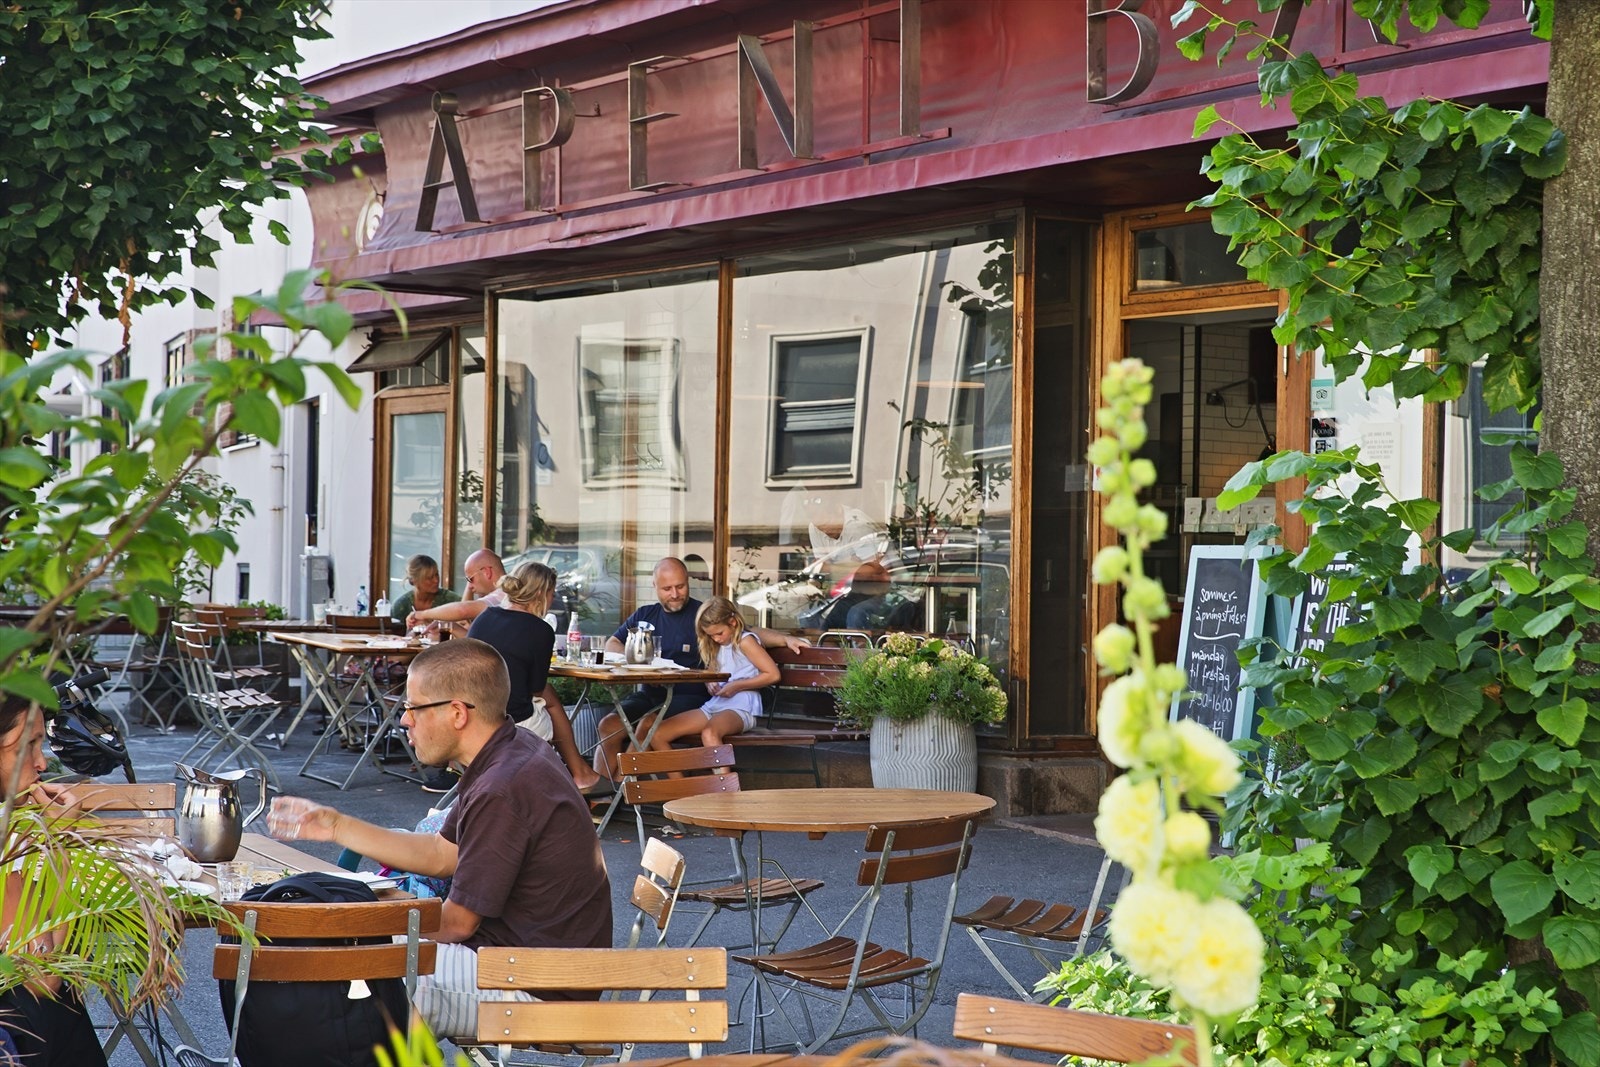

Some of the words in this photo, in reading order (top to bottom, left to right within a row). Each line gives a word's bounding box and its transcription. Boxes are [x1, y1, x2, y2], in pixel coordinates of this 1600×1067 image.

[1191, 644, 1225, 671] mandag
[1190, 663, 1200, 678] til
[1202, 664, 1231, 691] fredag
